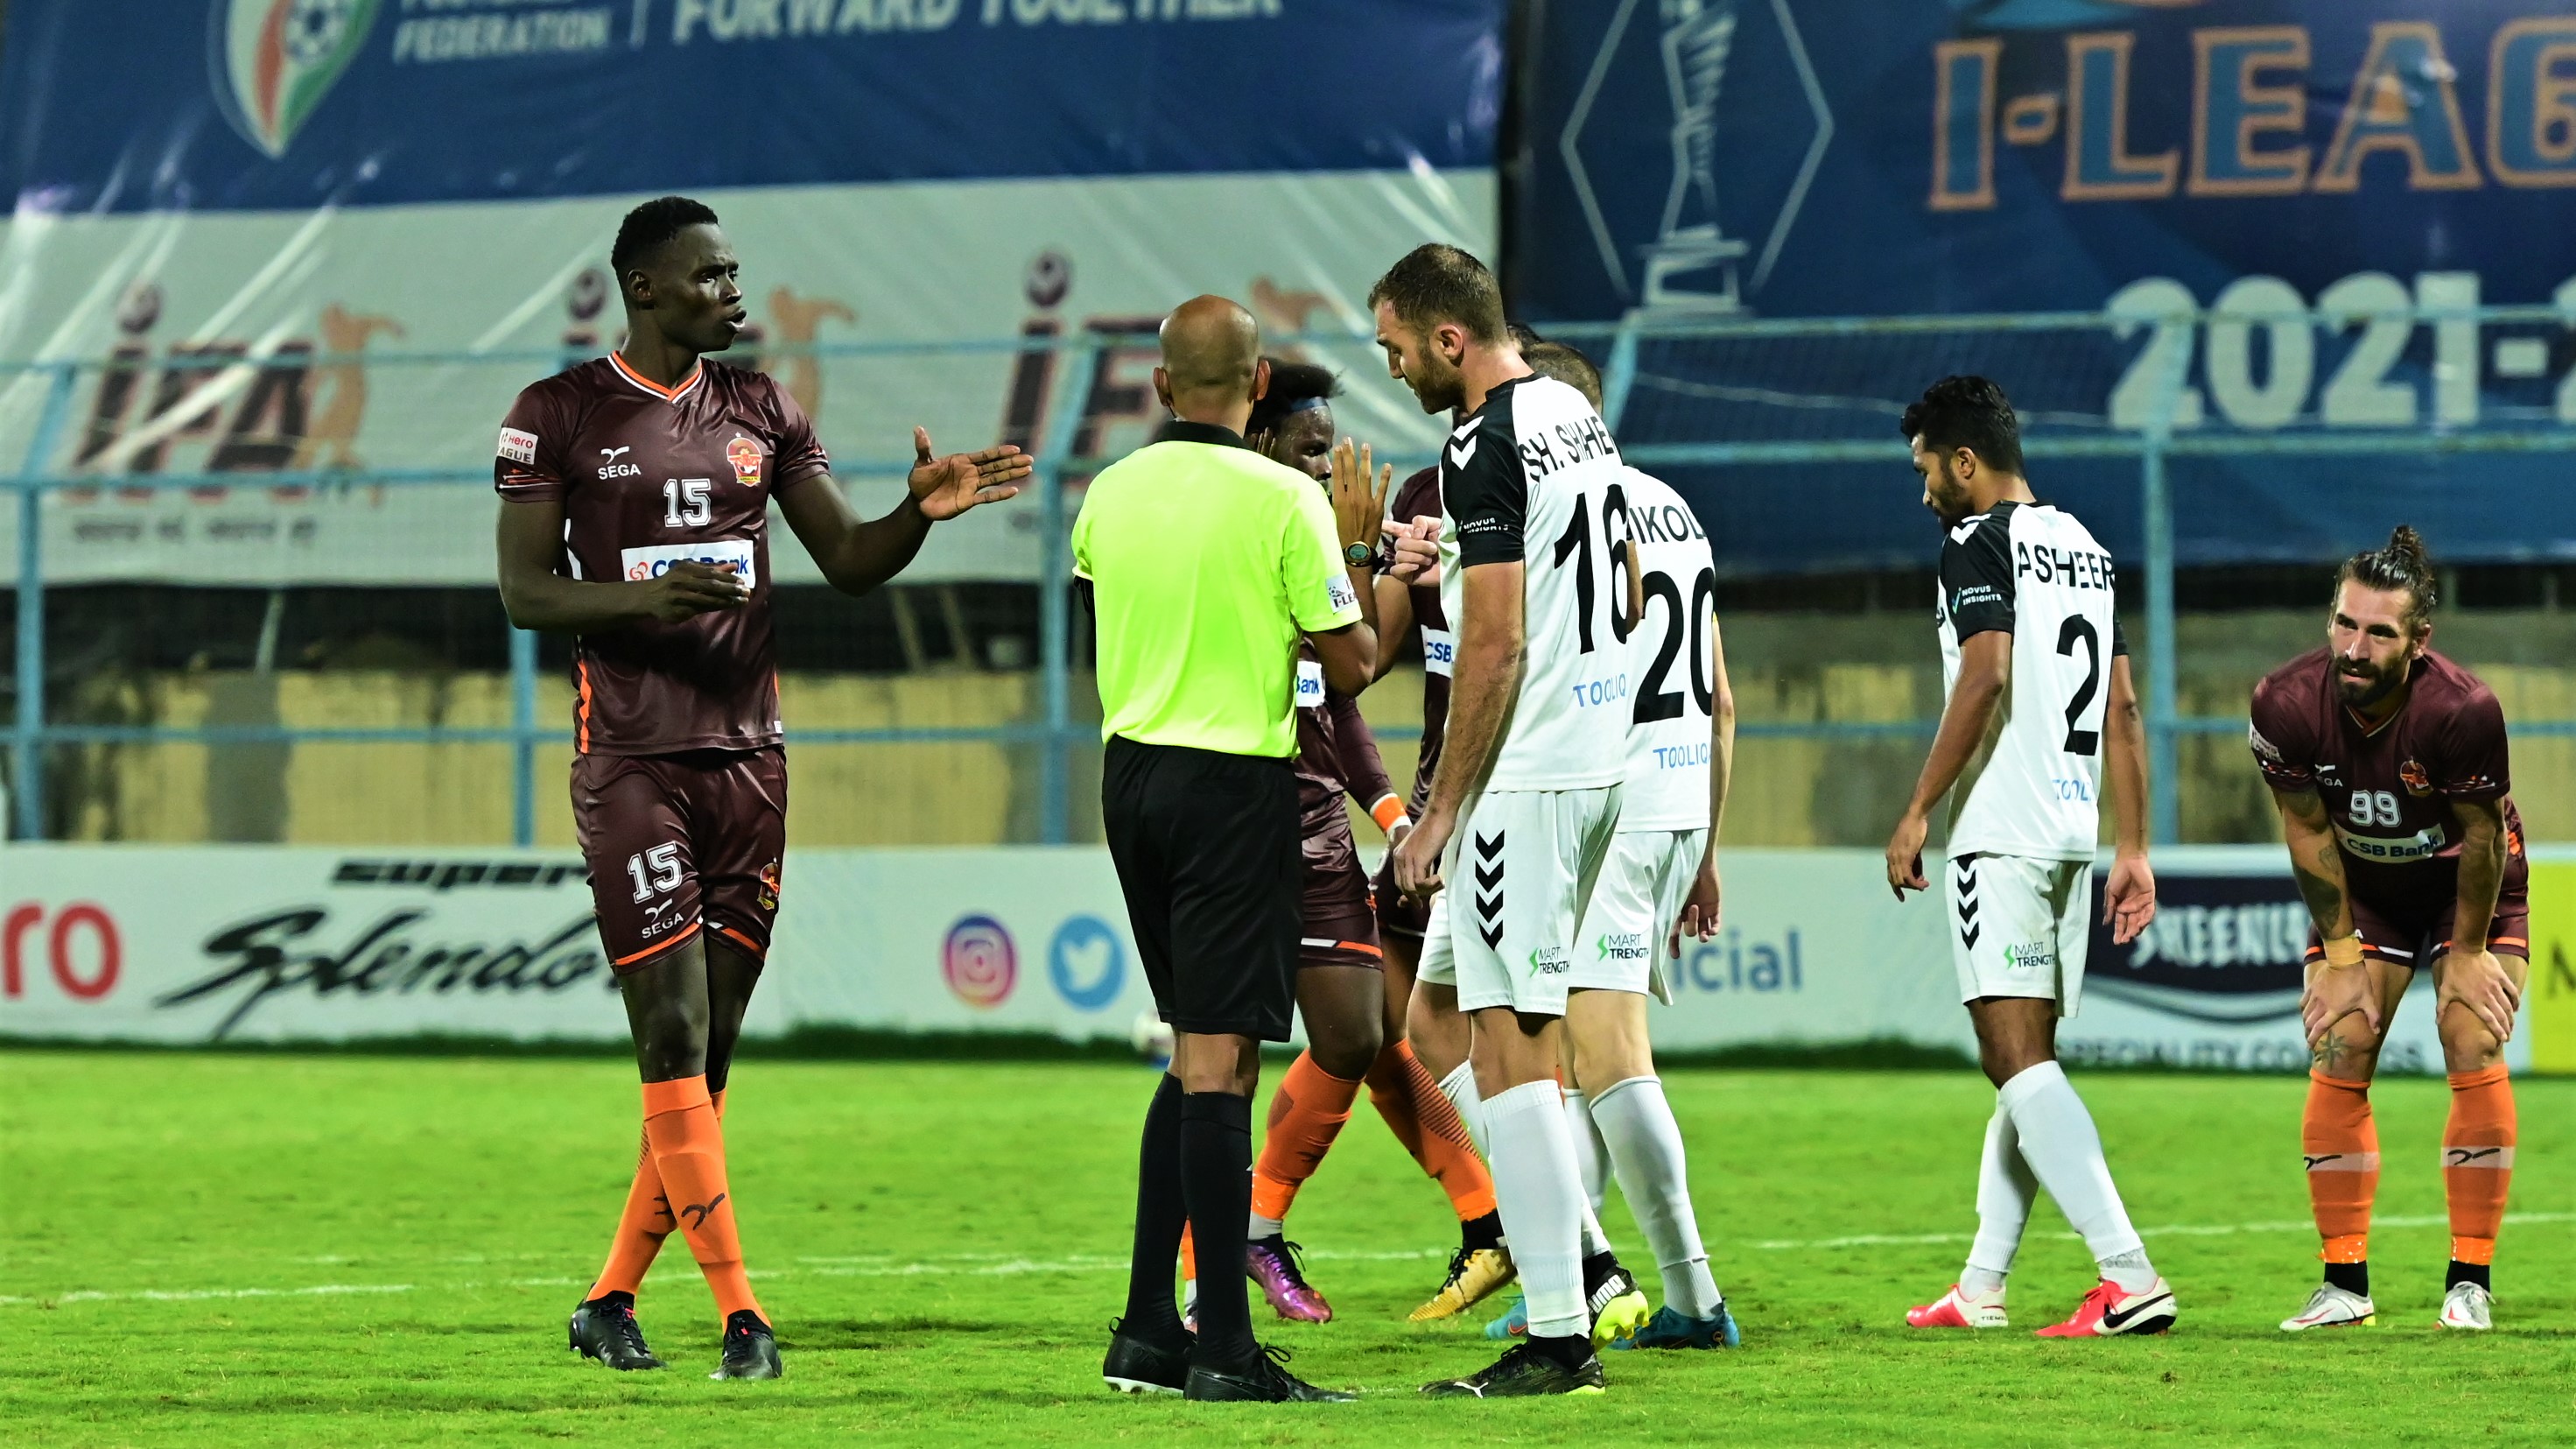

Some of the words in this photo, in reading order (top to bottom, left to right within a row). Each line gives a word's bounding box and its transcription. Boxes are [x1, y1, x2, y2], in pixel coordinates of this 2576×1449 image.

[2107, 271, 2576, 430] 2021-
[597, 464, 642, 480] SEGA
[663, 478, 712, 527] 15
[1628, 505, 1707, 545] IKOL
[1962, 585, 1991, 597] NOVUS
[1962, 594, 2002, 606] INSIGHTS
[1632, 566, 1716, 725] 20
[2056, 614, 2100, 756] 2
[2318, 777, 2343, 787] GA
[2349, 789, 2403, 828] 99
[2347, 838, 2386, 857] CSB
[2390, 834, 2439, 859] Bank
[627, 841, 683, 904] 15
[642, 912, 684, 939] SEGA
[153, 902, 625, 1042] Splendo
[1587, 1274, 1627, 1314] UMA
